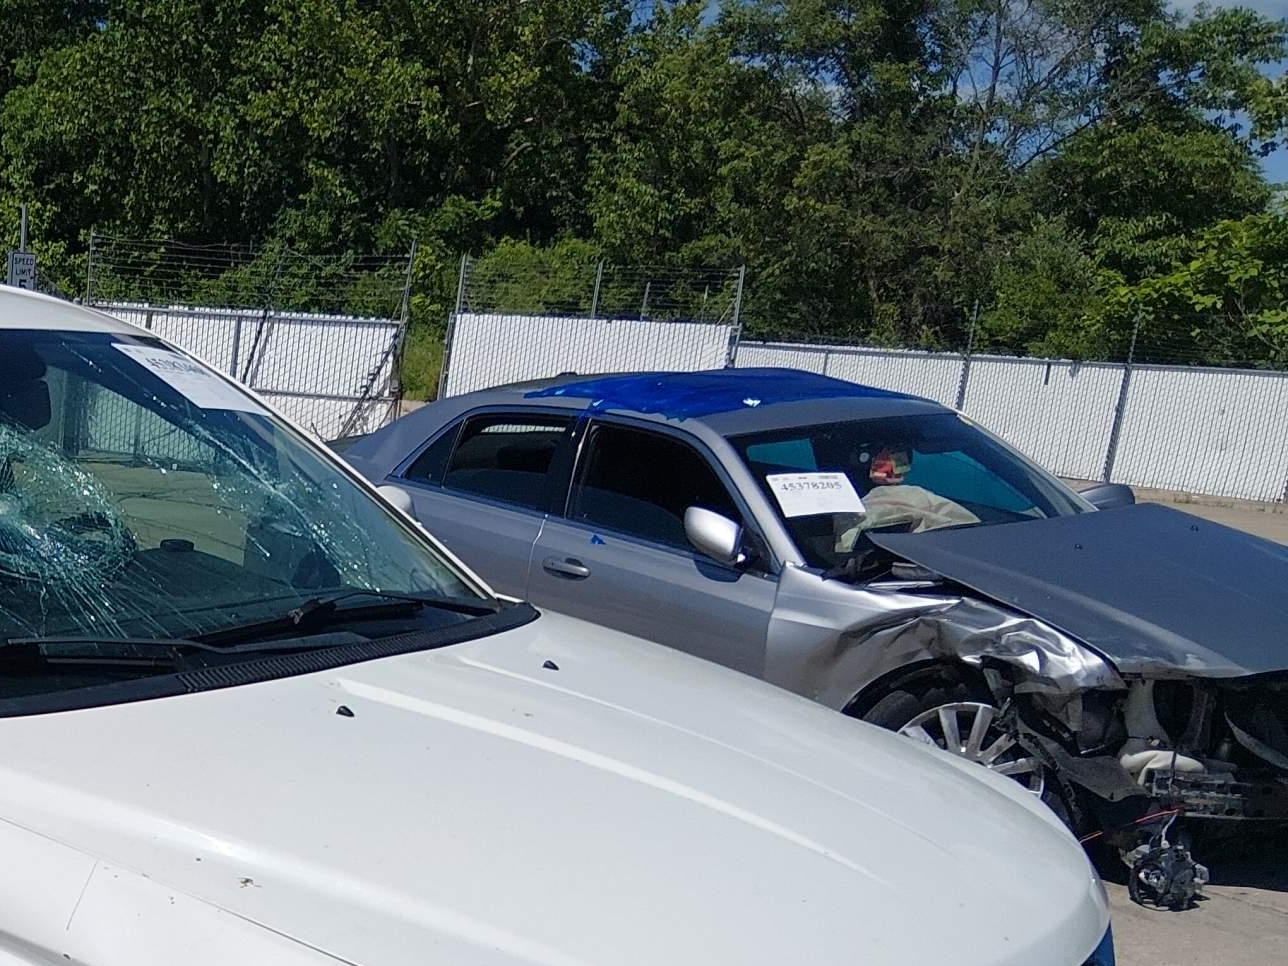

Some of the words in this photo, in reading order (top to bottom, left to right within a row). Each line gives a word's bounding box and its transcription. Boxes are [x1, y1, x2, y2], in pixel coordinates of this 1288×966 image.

[15, 257, 34, 265] SPEED
[15, 269, 32, 277] LIMIT
[781, 481, 843, 491] 45378205
